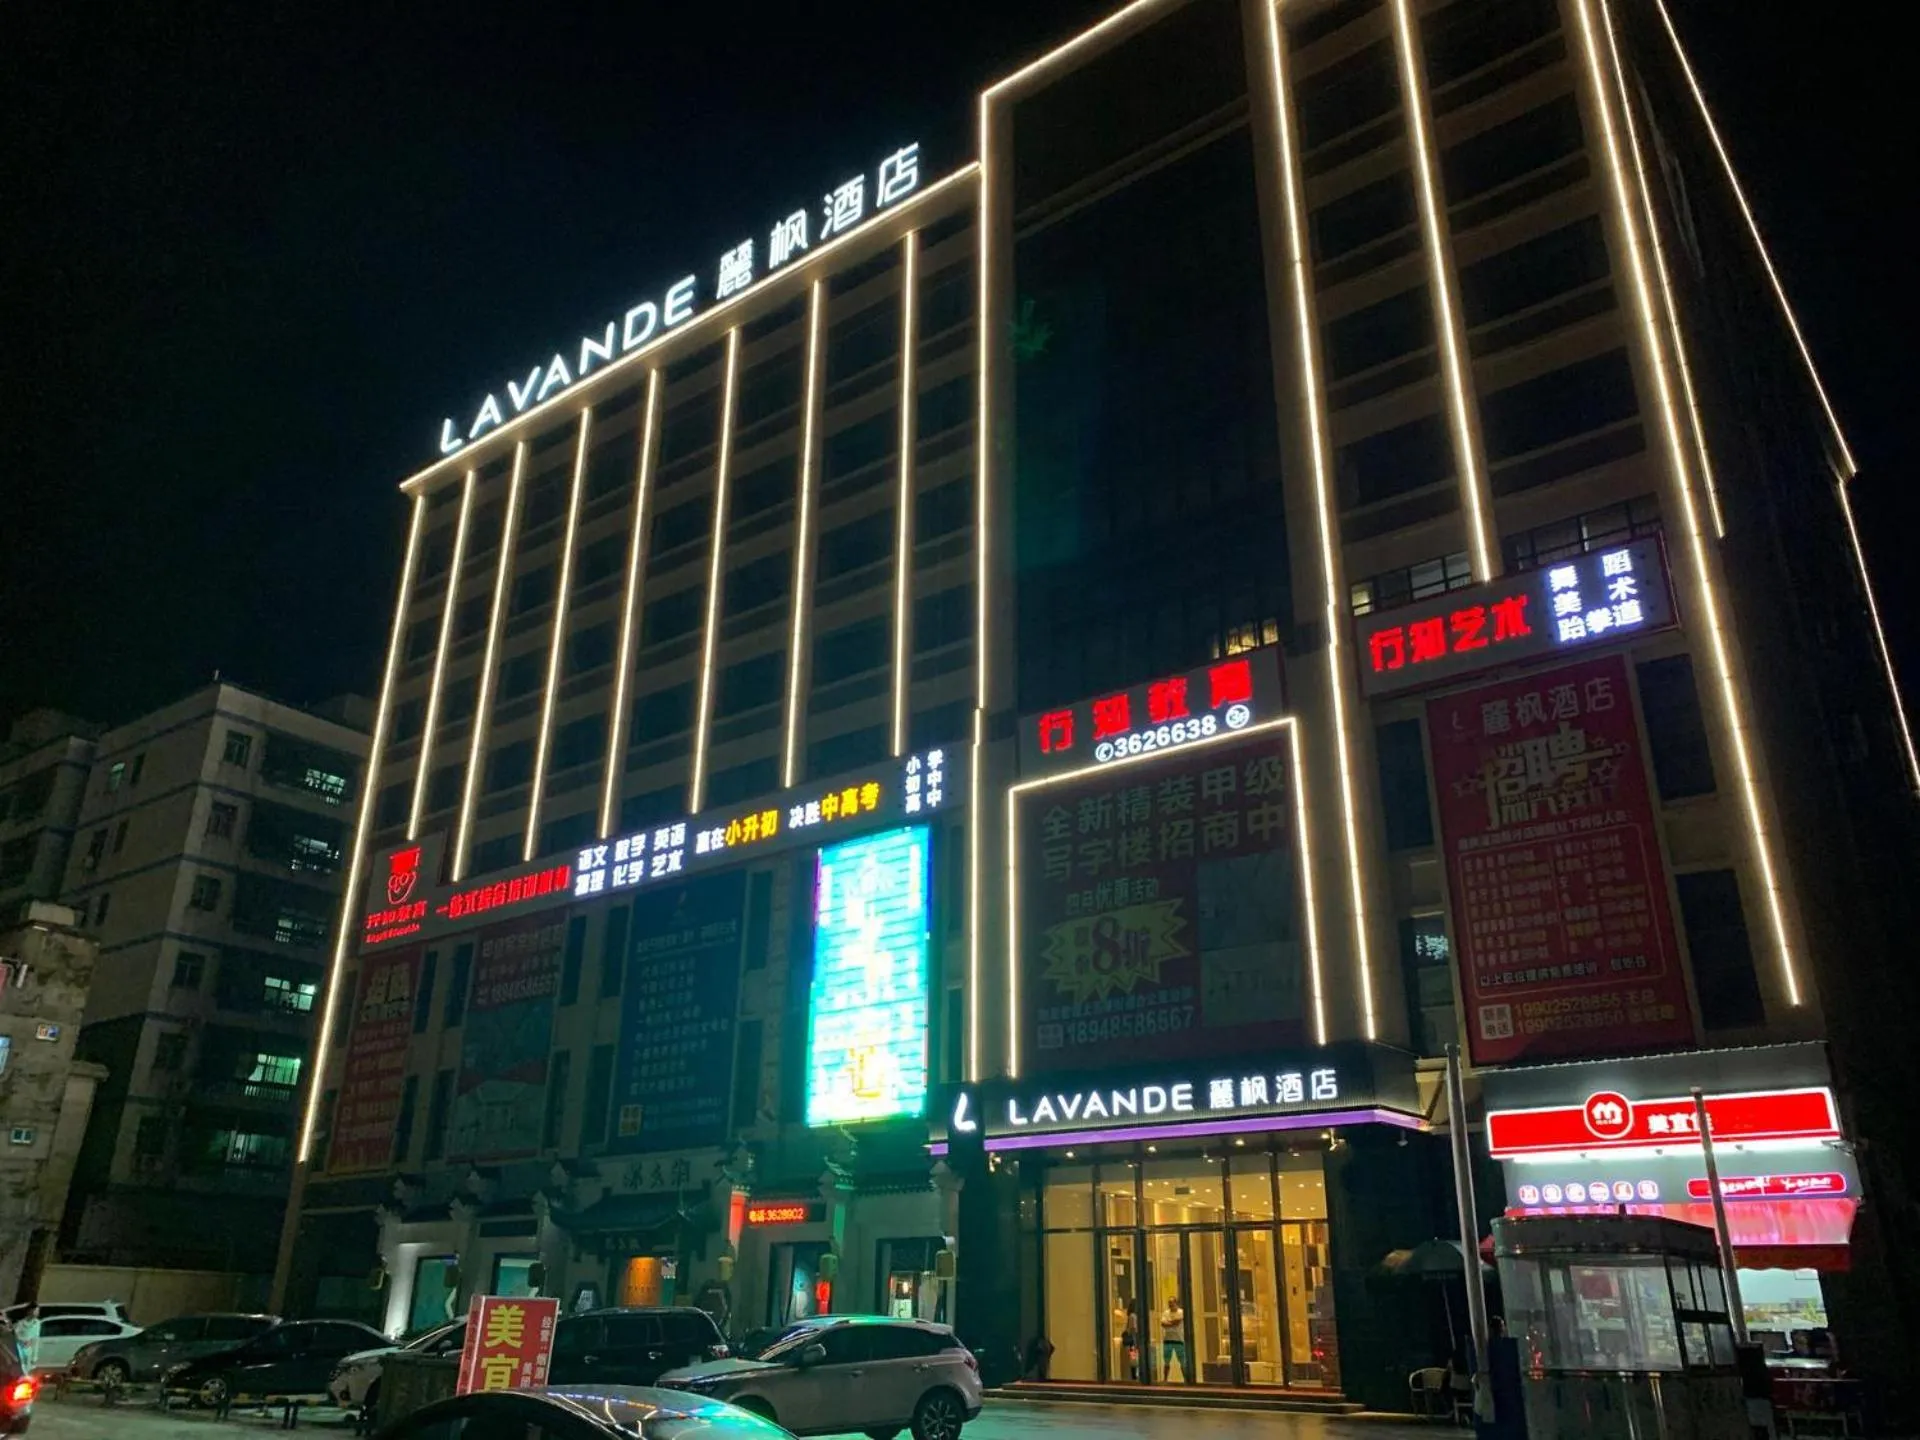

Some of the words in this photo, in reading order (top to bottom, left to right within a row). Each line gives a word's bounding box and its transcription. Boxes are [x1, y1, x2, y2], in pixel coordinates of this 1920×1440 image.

[440, 274, 696, 453] LAVANDE
[1554, 577, 1638, 617] 美术
[1369, 594, 1532, 672] 行知艺术
[1038, 660, 1254, 755] 行知教育
[1113, 714, 1218, 757] 3626638
[905, 770, 943, 795] 初中
[906, 749, 944, 775] 小学
[787, 782, 881, 829] 决胜中高考
[905, 788, 943, 814] 高中
[1041, 756, 1286, 844] 全新精装甲级
[578, 845, 607, 871] 语文
[614, 833, 647, 862] 数学
[653, 822, 686, 850] 英语
[1042, 801, 1287, 884] 写字楼招商中
[611, 859, 643, 887] 化学
[650, 849, 683, 877] 艺术
[1008, 1083, 1194, 1125] LAVANDE
